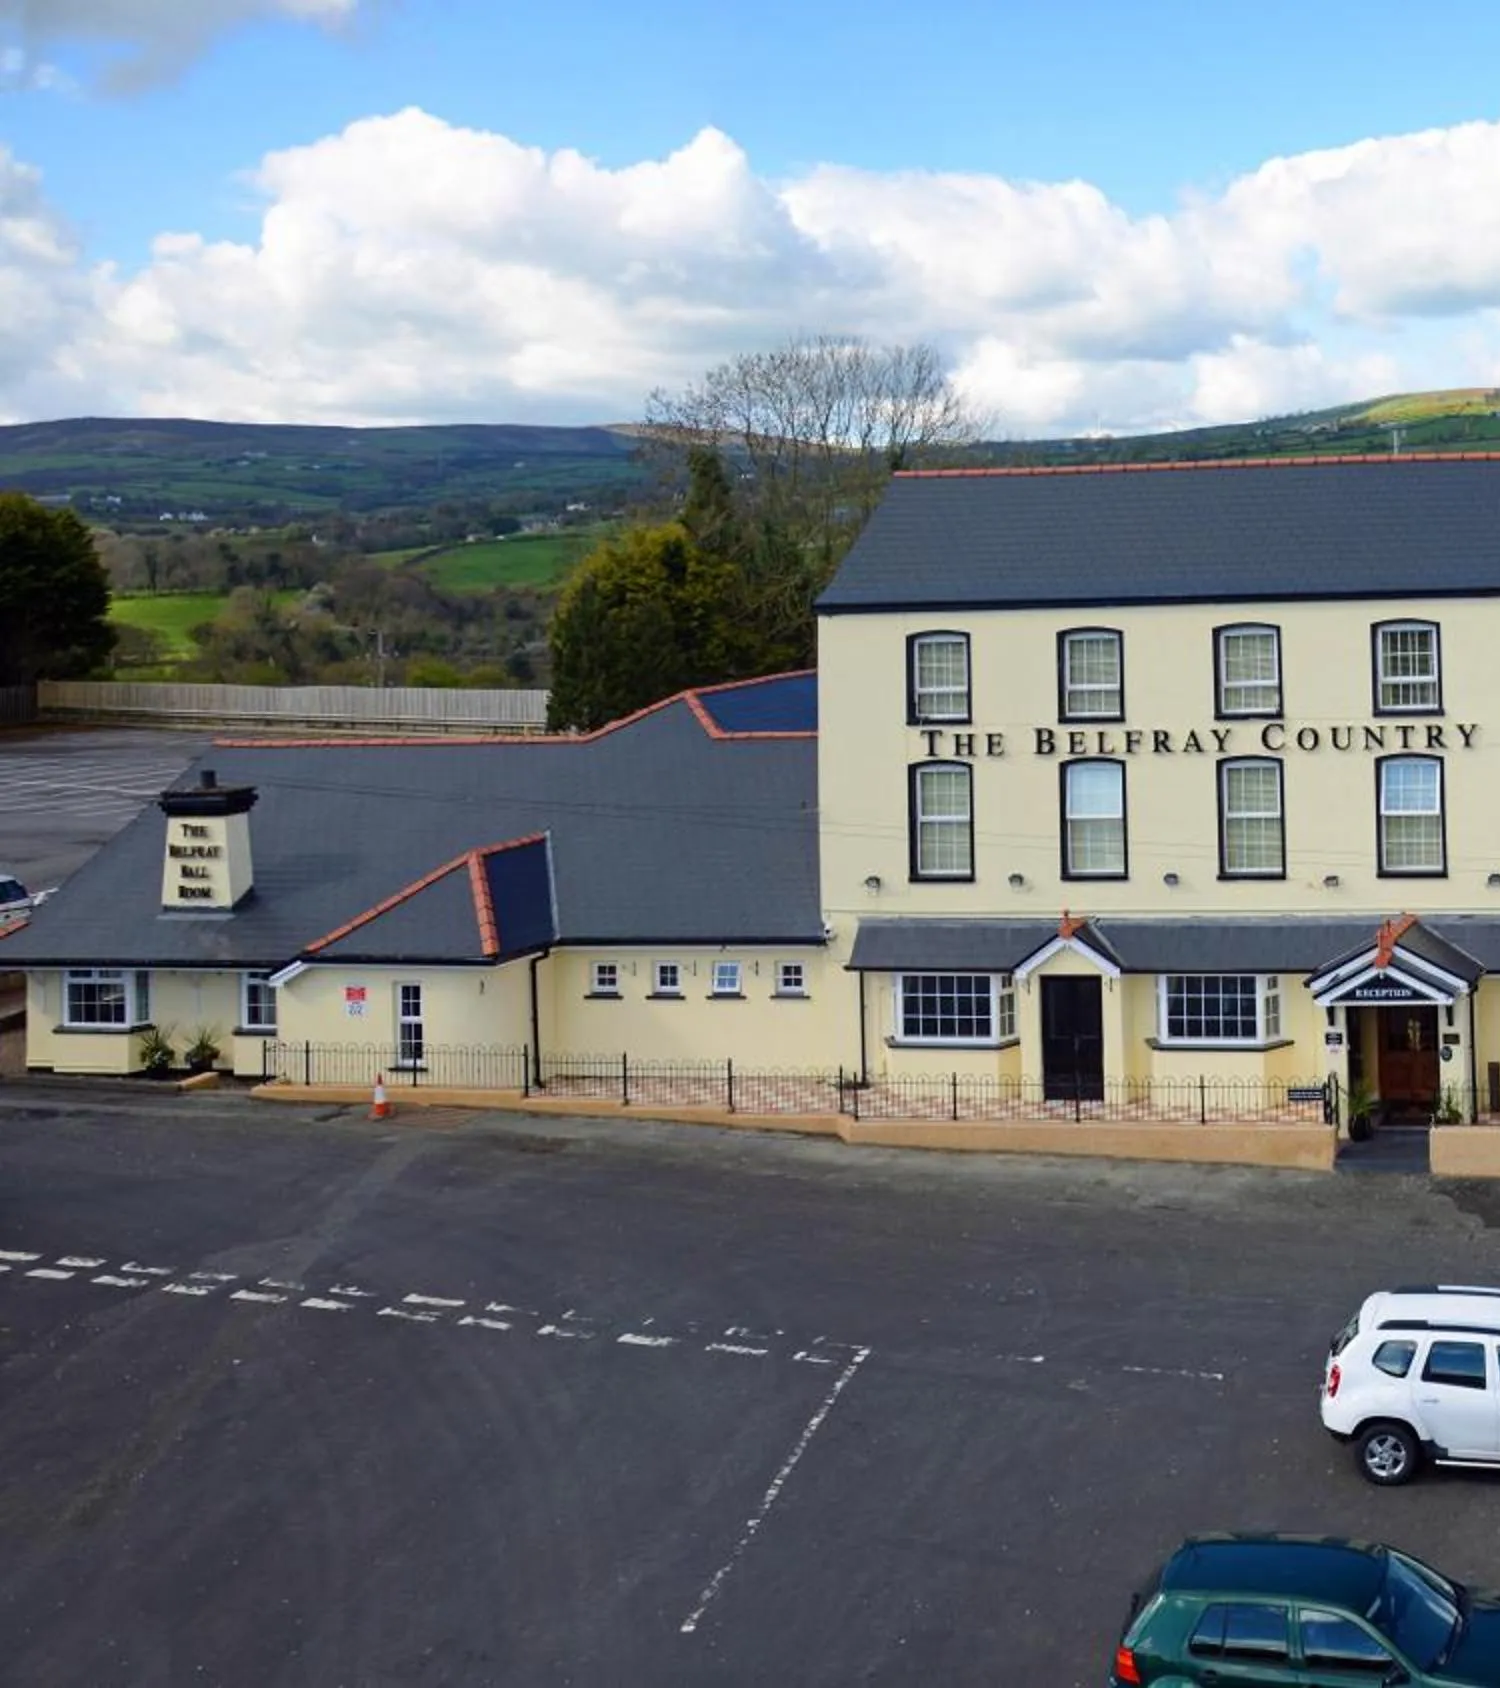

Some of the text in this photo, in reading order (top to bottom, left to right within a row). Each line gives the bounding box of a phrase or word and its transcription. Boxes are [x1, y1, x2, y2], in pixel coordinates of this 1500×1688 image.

[920, 730, 1005, 757] THE
[1033, 727, 1232, 756] BELFRAY
[1260, 722, 1479, 752] COUNTRY
[1355, 987, 1412, 998] RECEPTION
